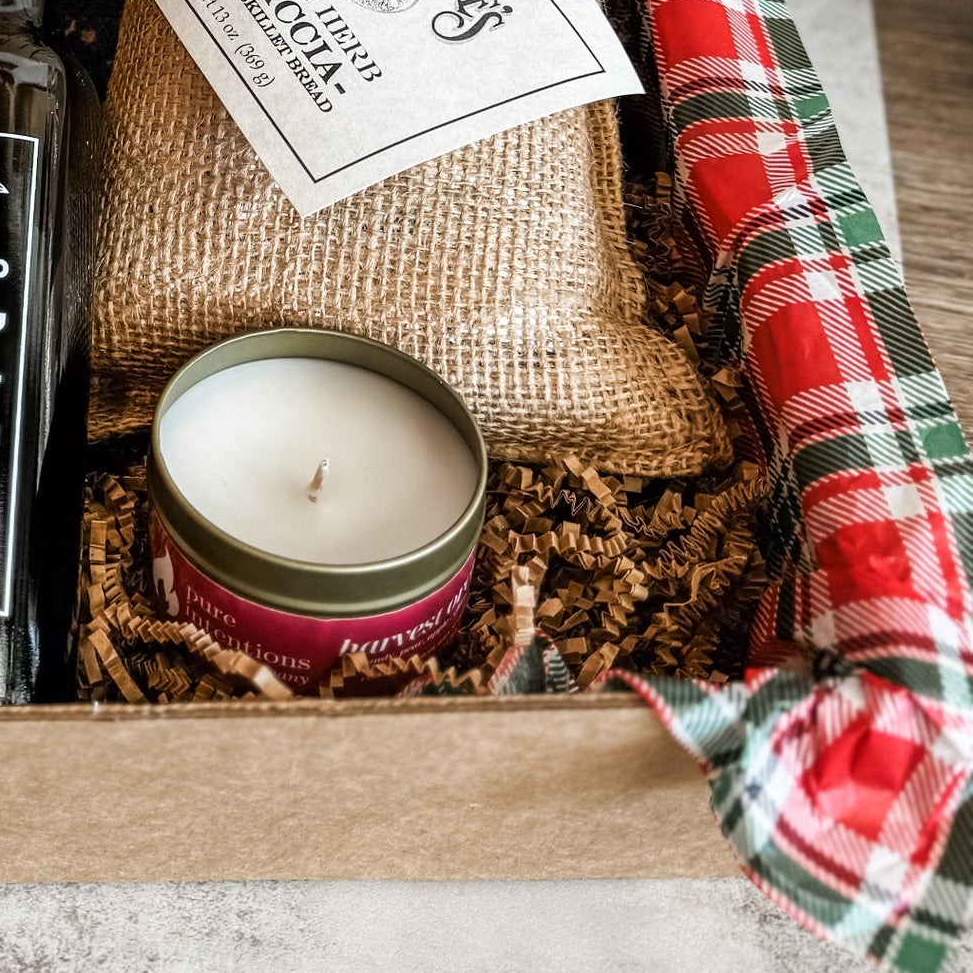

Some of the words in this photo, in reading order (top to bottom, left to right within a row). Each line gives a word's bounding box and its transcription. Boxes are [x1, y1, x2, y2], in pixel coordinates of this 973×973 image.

[212, 5, 230, 24] 13
[223, 23, 240, 41] oz
[234, 42, 266, 70] (369
[252, 71, 276, 88] g)
[314, 5, 383, 83] HERB
[285, 56, 334, 113] BREAD
[186, 584, 237, 627] pure
[186, 600, 311, 670] intentions
[339, 607, 443, 657] harvest
